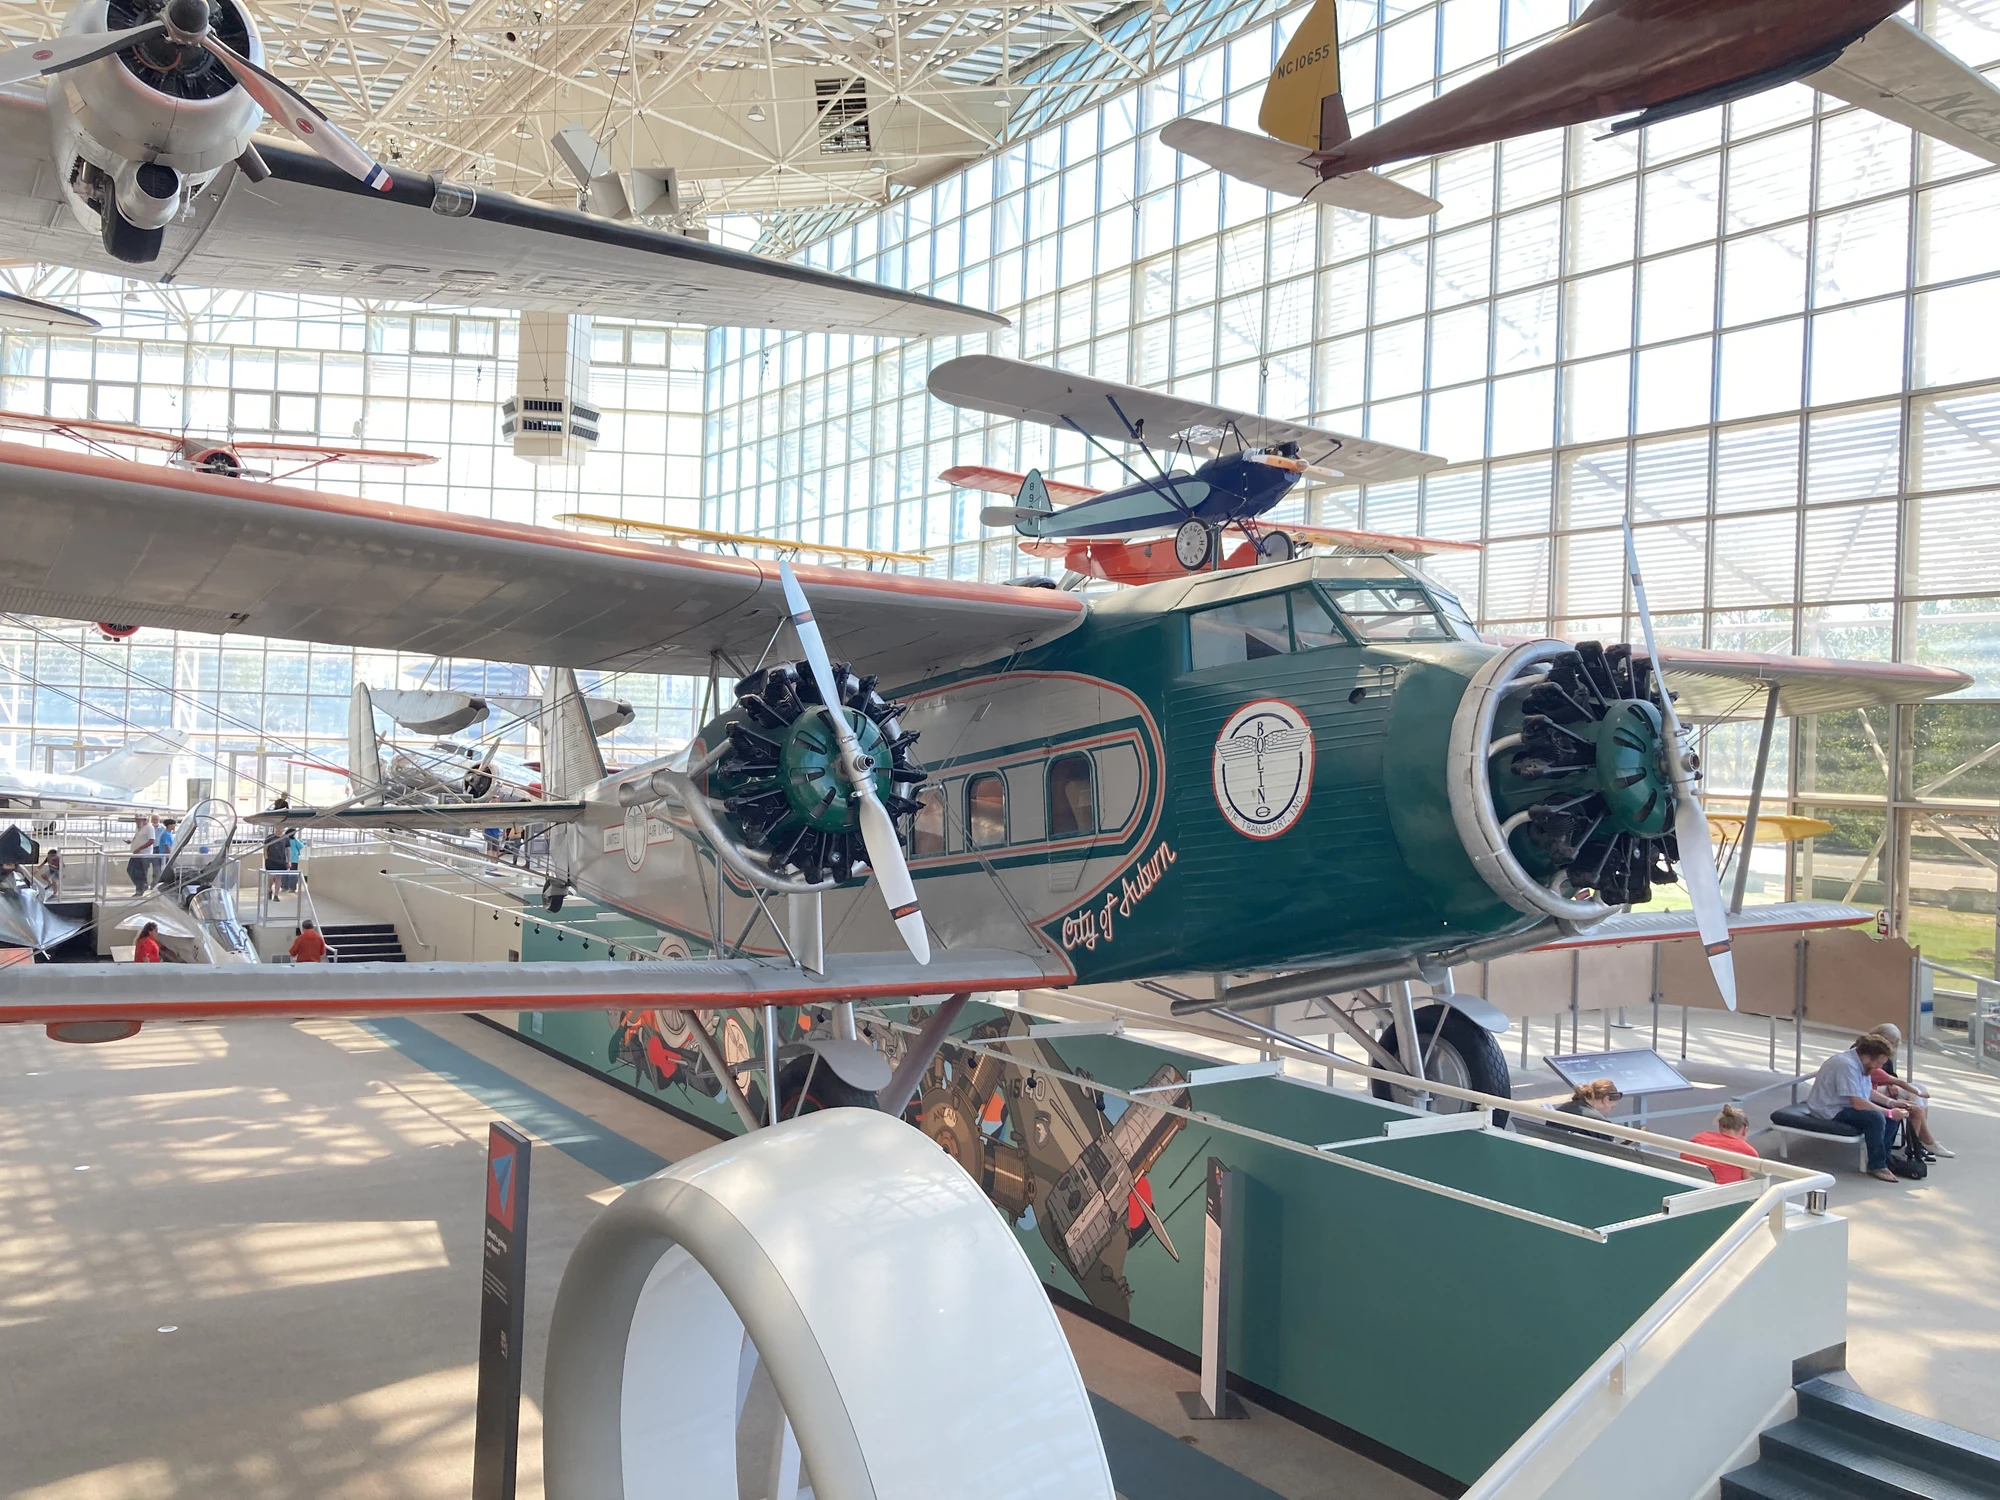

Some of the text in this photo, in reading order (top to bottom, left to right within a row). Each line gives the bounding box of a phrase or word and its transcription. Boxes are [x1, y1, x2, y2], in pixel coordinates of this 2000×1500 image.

[1225, 805, 1238, 822] AIR
[1255, 720, 1271, 818] BOEING
[1062, 841, 1178, 951] City of Auburn
